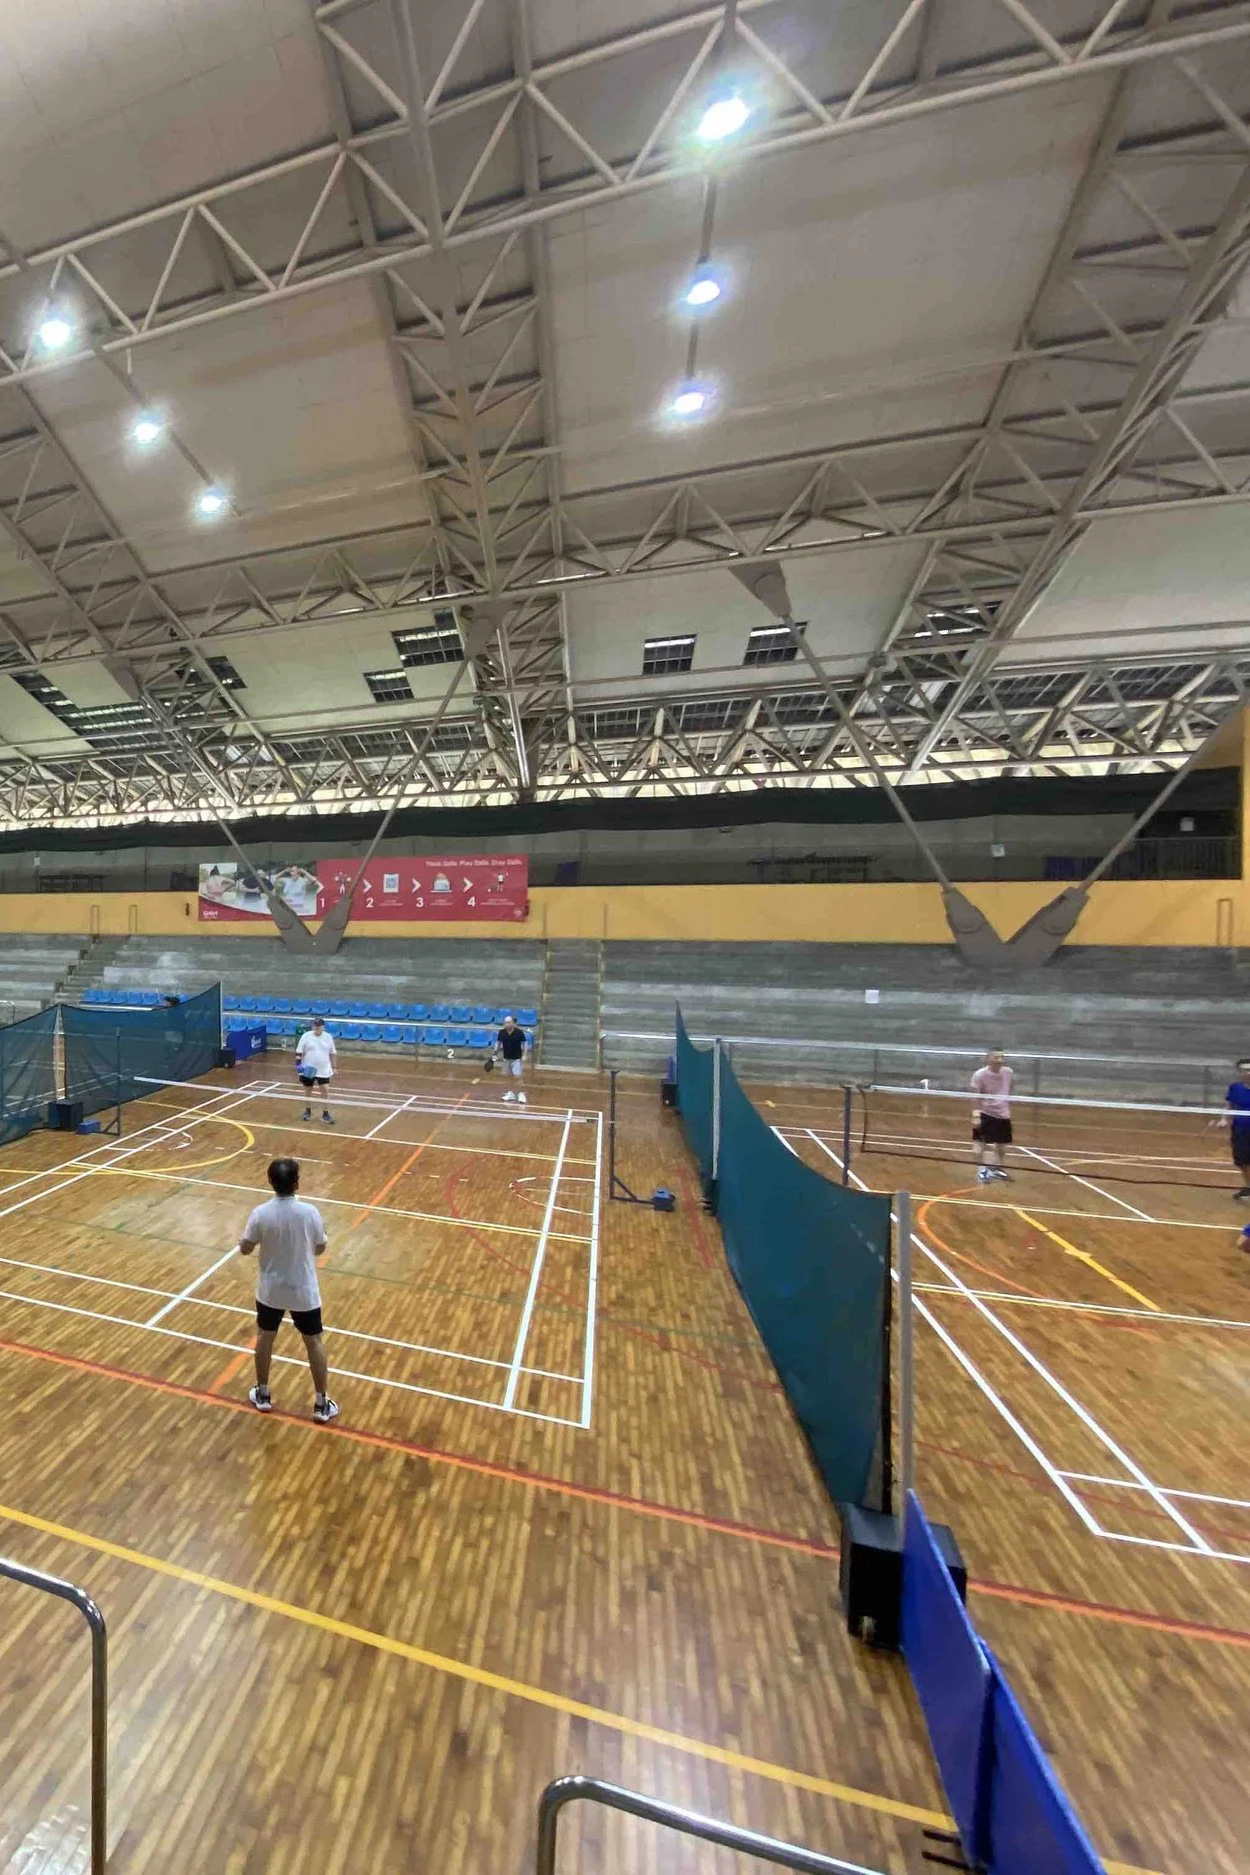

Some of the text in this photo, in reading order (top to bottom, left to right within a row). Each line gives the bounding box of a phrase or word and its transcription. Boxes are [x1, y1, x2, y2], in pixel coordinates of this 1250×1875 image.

[320, 897, 325, 908] 1
[366, 897, 374, 908] 2
[416, 897, 424, 908] 3
[467, 896, 476, 907] 4
[447, 1049, 454, 1058] 2
